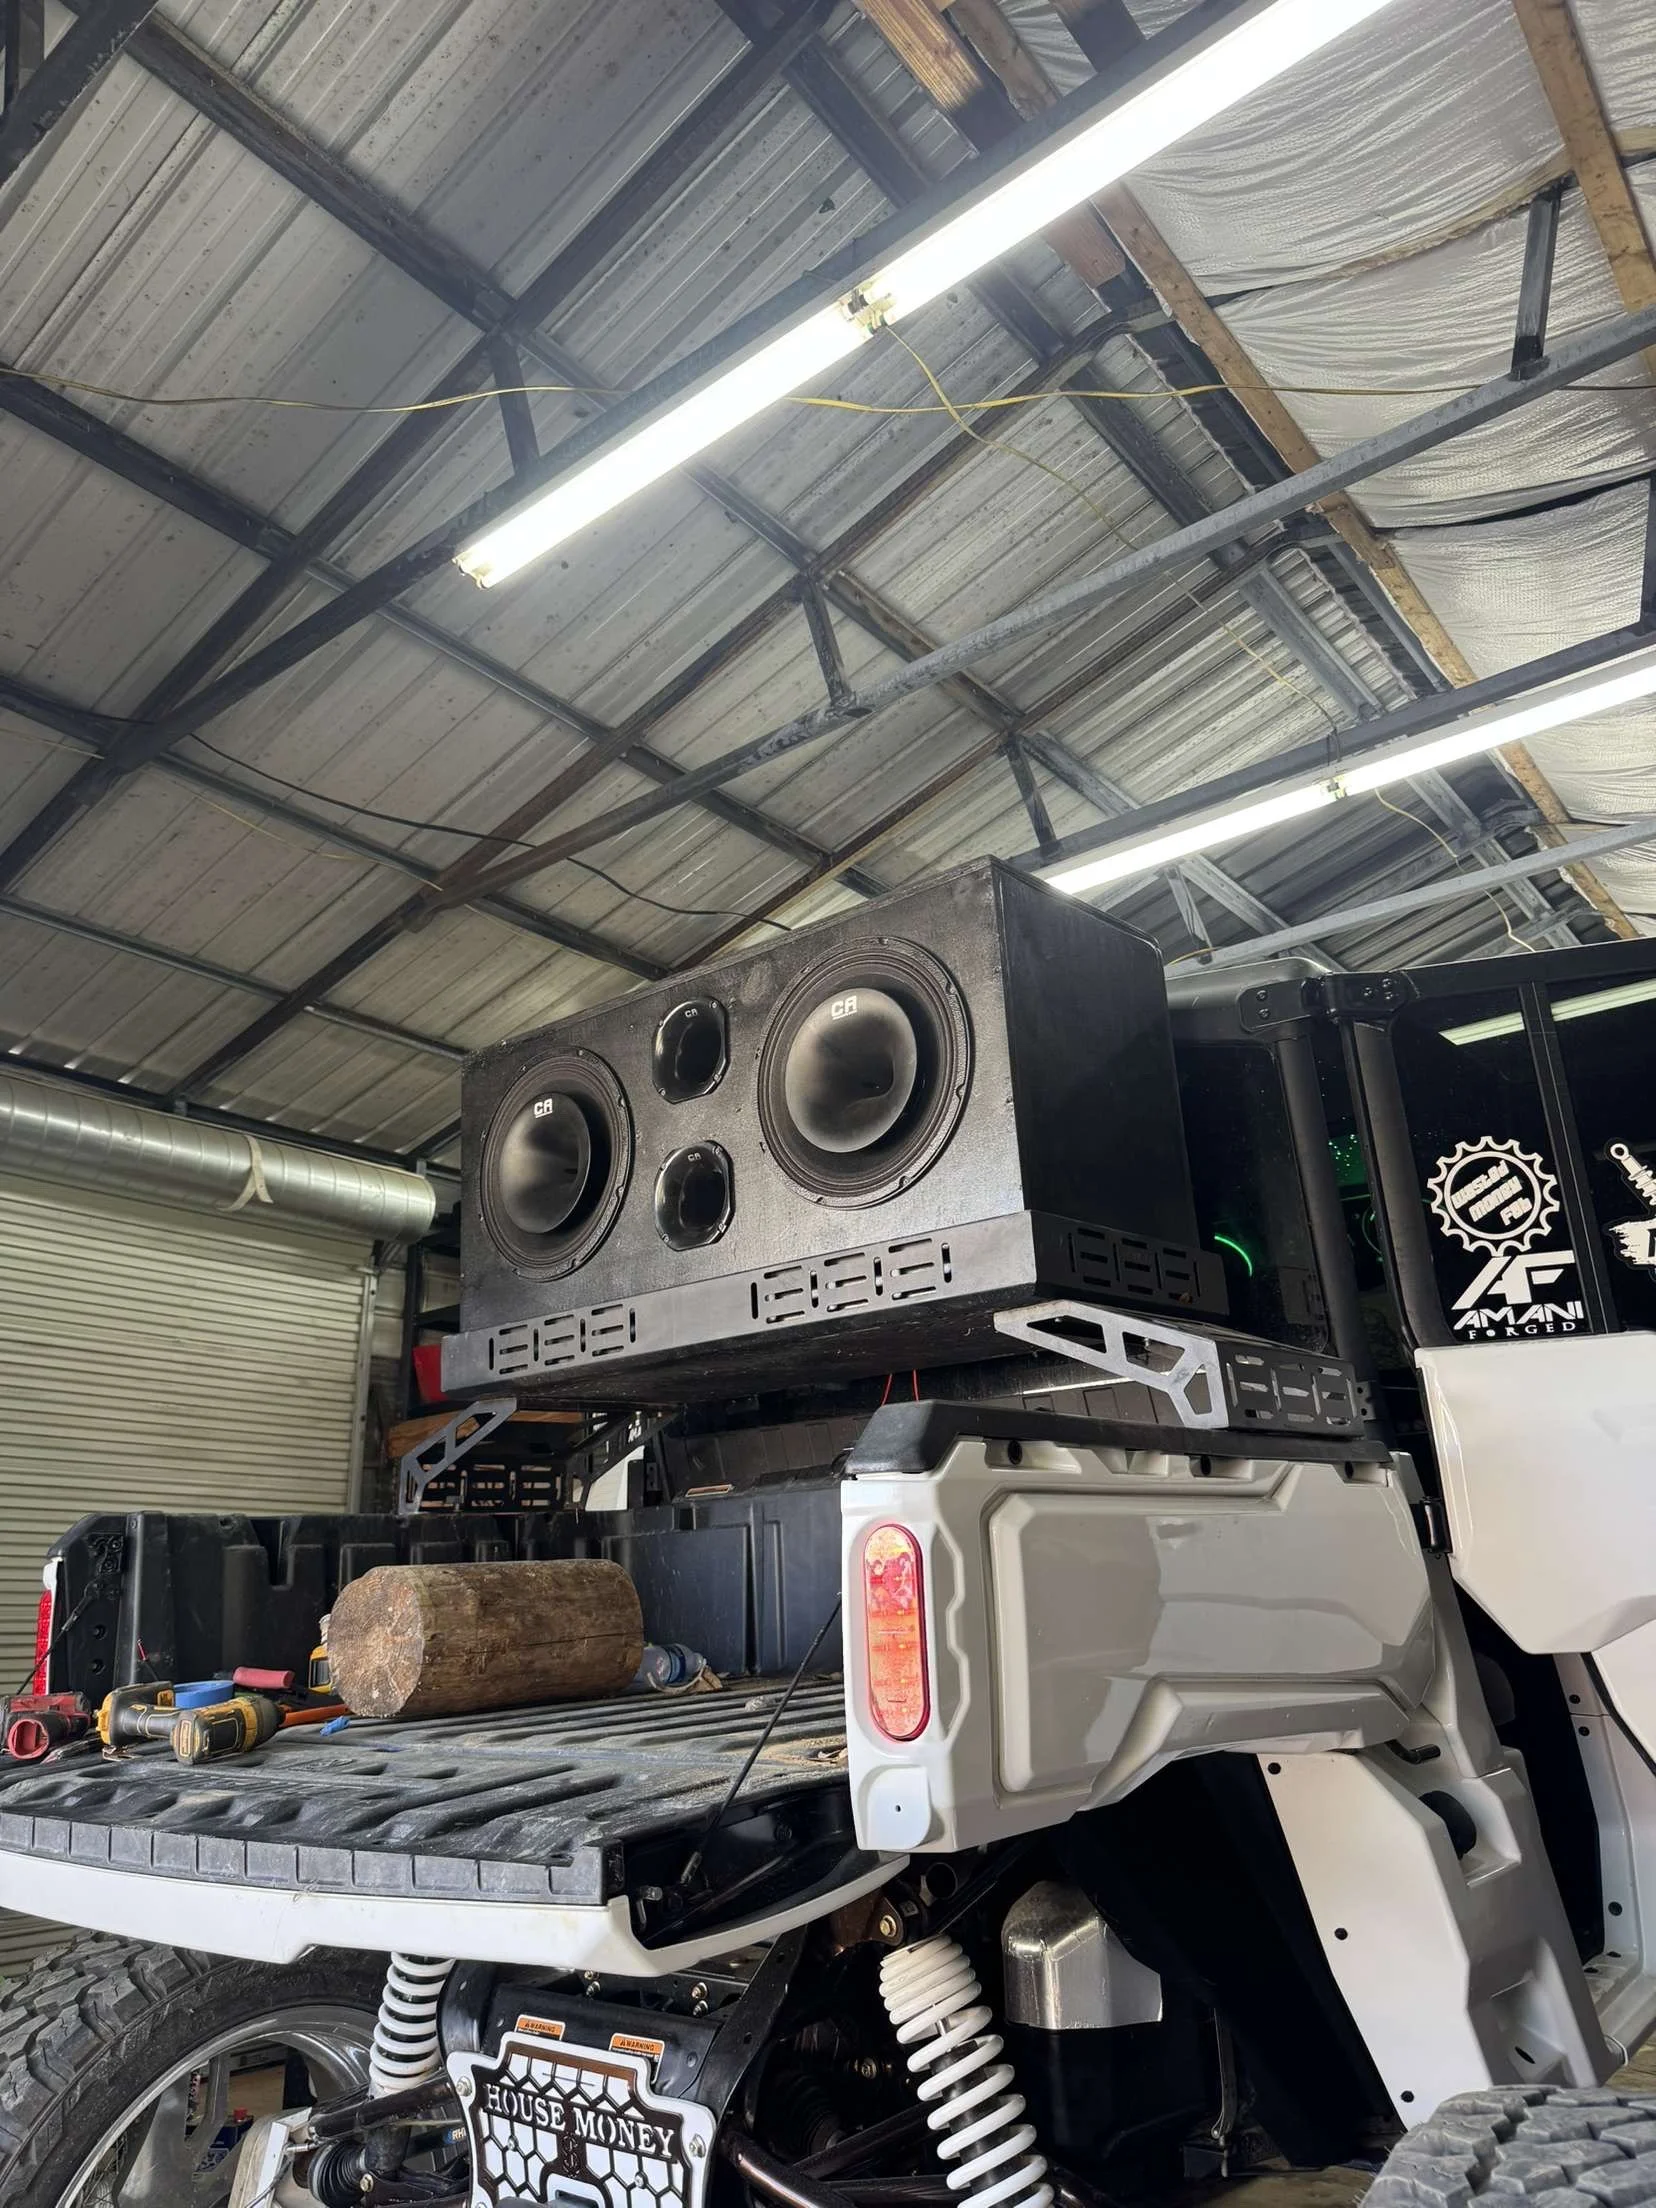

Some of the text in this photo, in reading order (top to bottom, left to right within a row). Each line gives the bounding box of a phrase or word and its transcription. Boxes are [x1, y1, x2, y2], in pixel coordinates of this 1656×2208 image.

[1453, 1300, 1585, 1330] AMANI
[1469, 1321, 1577, 1340] FORGED
[530, 2022, 556, 2034] WARNING
[627, 2039, 656, 2051] WARNING
[485, 2083, 675, 2158] HOUSE MONEY
